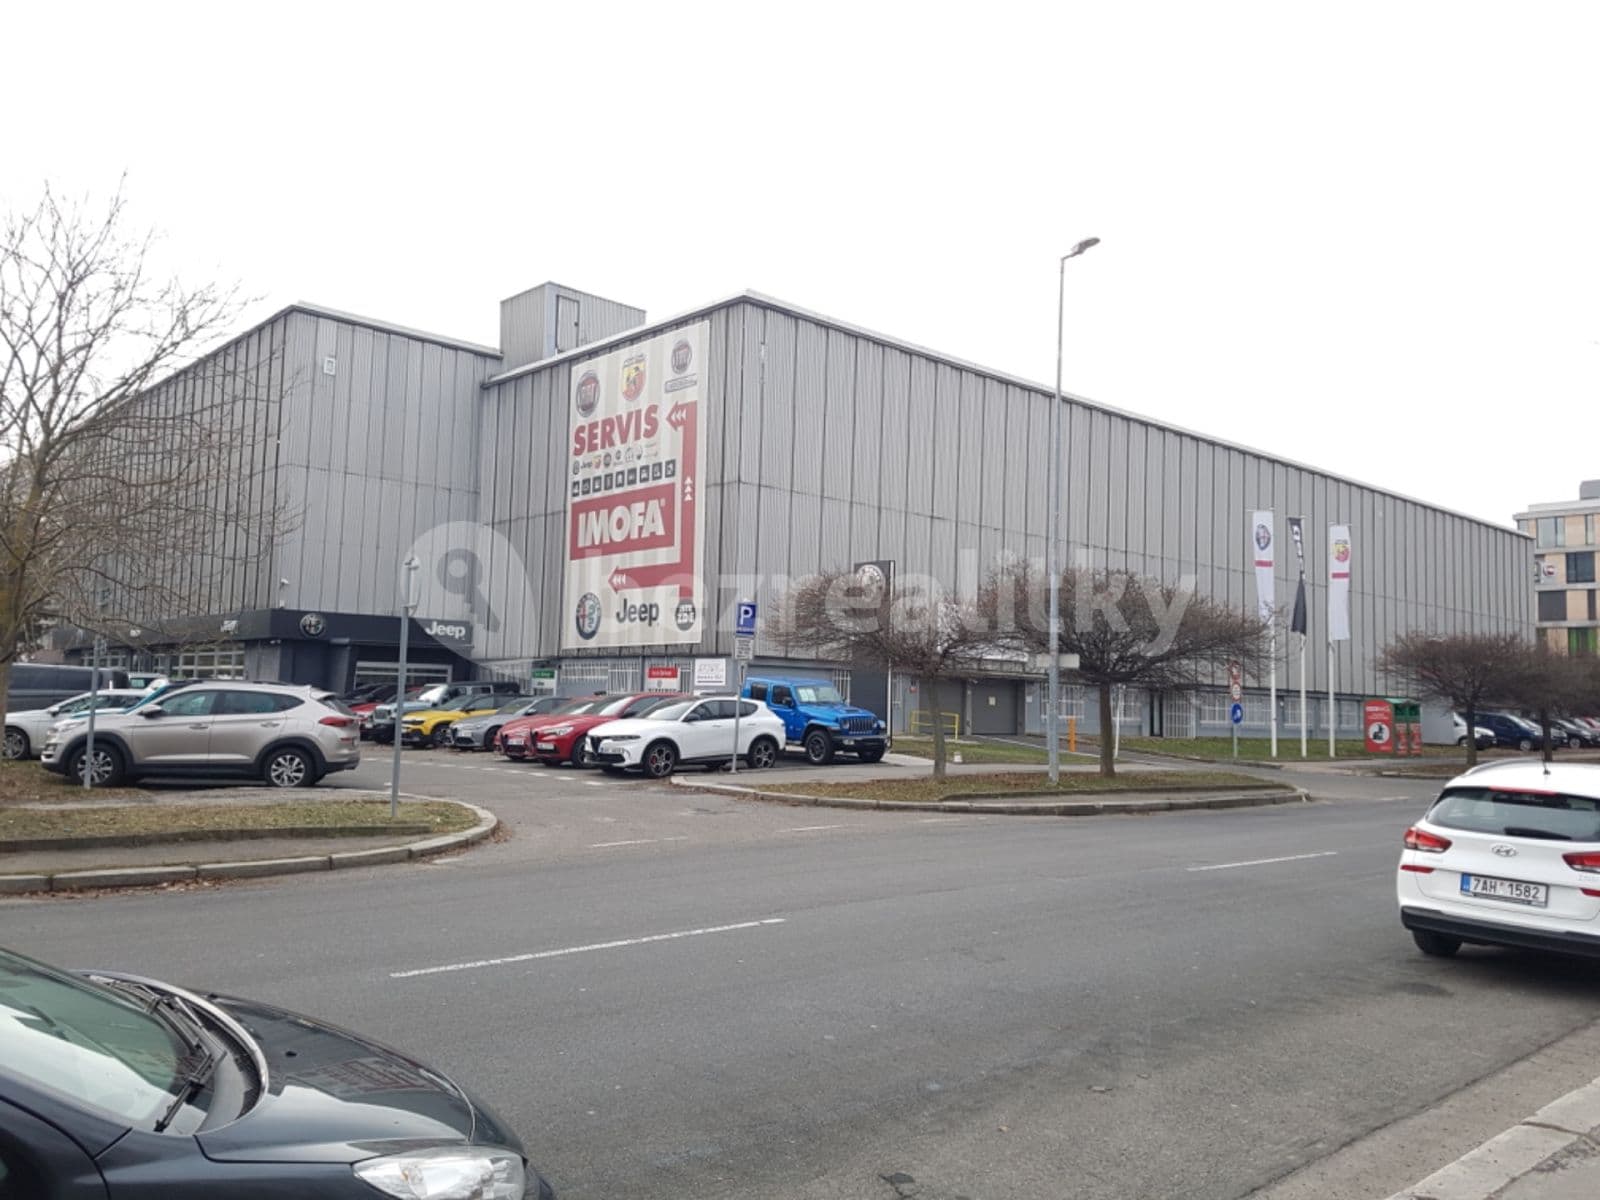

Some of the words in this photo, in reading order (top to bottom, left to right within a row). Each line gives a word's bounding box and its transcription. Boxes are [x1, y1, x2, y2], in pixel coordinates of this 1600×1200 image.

[573, 404, 660, 457] SERVIS
[577, 499, 666, 548] IMOFA
[616, 598, 660, 627] Jeep
[740, 606, 753, 625] P
[425, 620, 466, 640] Jeep
[1473, 878, 1499, 894] 7AH
[1509, 883, 1541, 900] 1582
